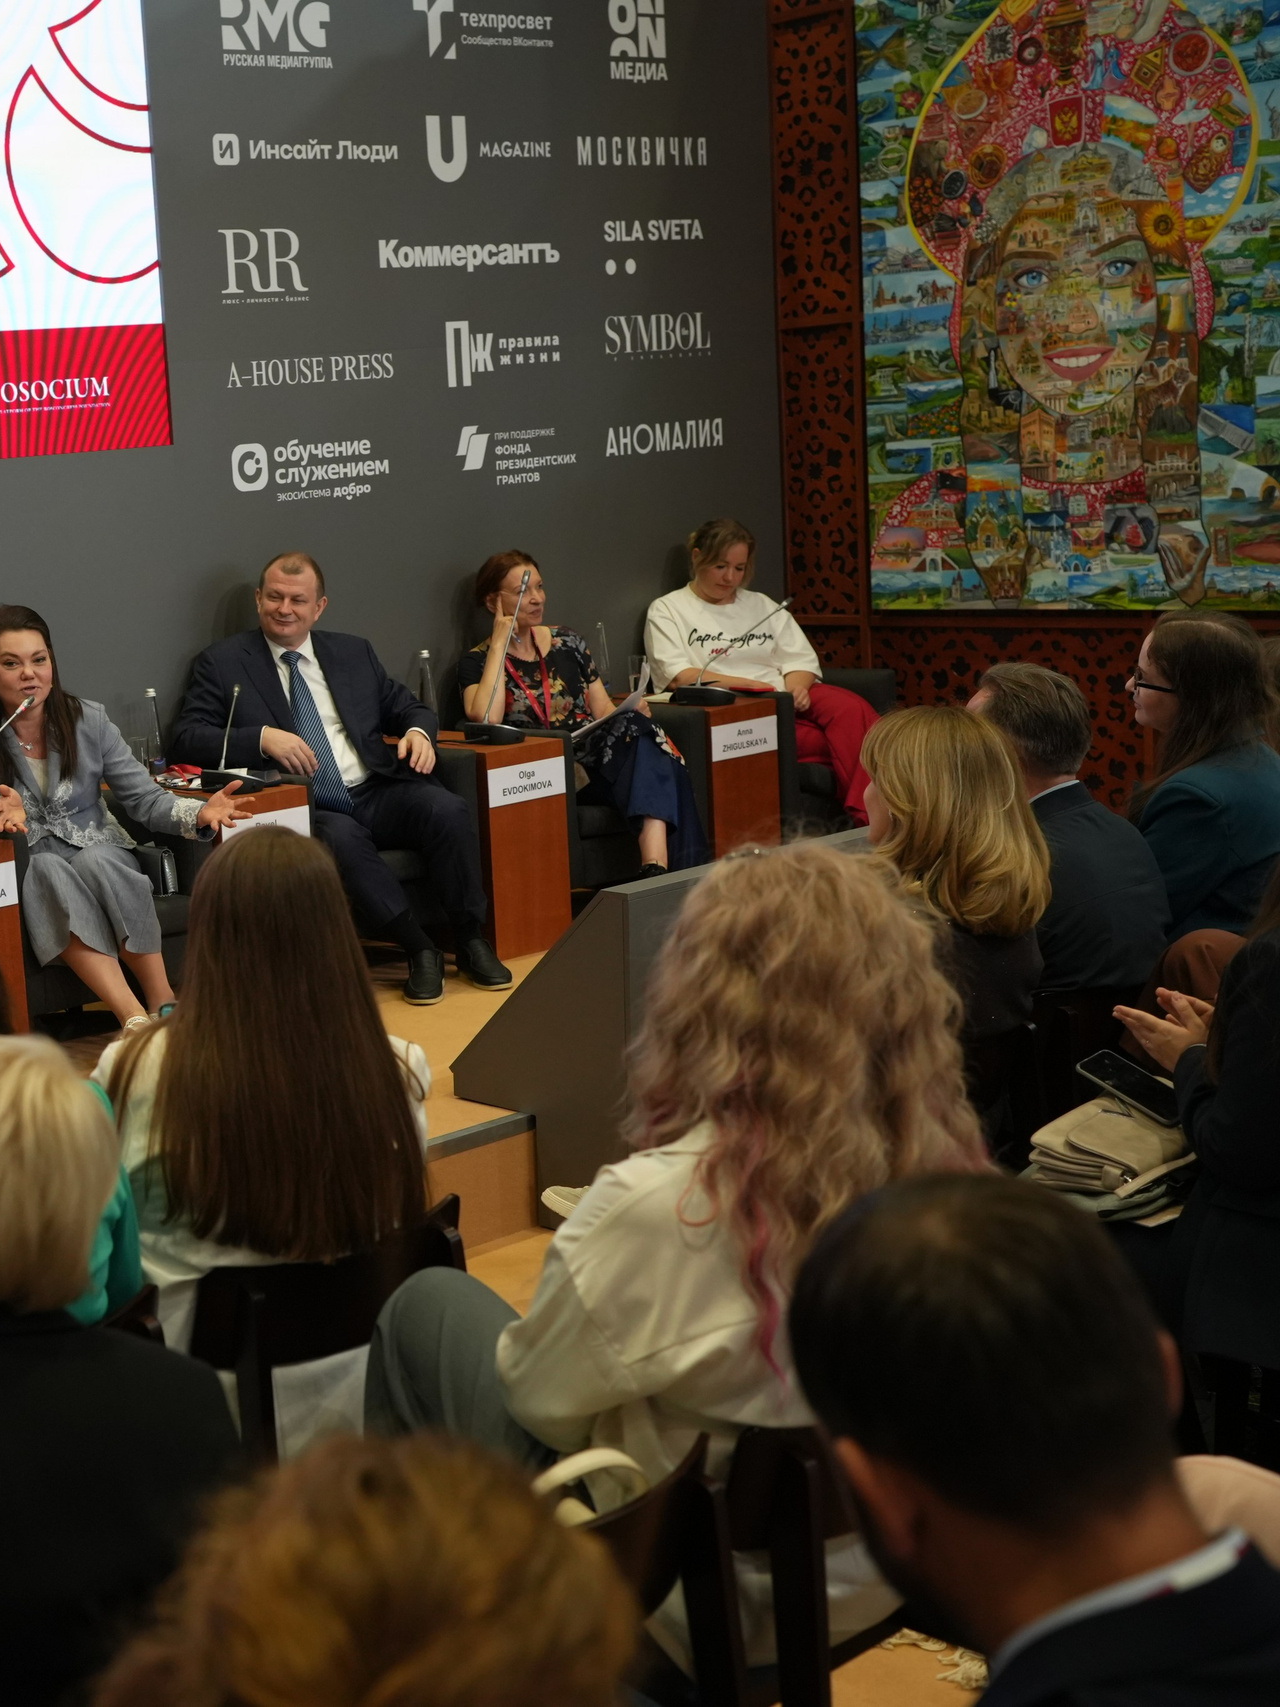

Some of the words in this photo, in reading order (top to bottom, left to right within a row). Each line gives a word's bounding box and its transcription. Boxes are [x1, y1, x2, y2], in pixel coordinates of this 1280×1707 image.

[460, 12, 553, 32] техпросвет
[461, 34, 512, 46] Сообщество
[513, 36, 554, 47] ВКонтакте
[223, 54, 265, 67] РУССКАЯ
[267, 55, 333, 69] МЕДИАГРУППА
[610, 61, 668, 83] МЕДИА
[249, 138, 332, 160] Инсайт
[336, 140, 399, 163] Люди
[425, 115, 468, 183] U
[479, 141, 552, 158] MAGAZINE
[576, 136, 708, 166] МОСКВИЧКА
[603, 220, 644, 242] SILA
[647, 219, 704, 241] SVETA
[218, 228, 309, 294] RR
[604, 312, 711, 355] SYMBOL
[499, 335, 560, 352] правила
[445, 320, 494, 388] ПЖ
[500, 351, 560, 365] жизни
[226, 356, 326, 388] A-HOUSE
[330, 352, 395, 383] PRESS
[494, 432, 509, 440] ПРИ
[510, 428, 555, 439] ПОДДЕРЖКЕ
[606, 418, 724, 457] АНОМАЛИЯ
[273, 439, 371, 465] обучение
[495, 443, 531, 455] ФОНДА
[496, 454, 576, 470] ПРЕЗИДЕНТСКИХ
[274, 459, 390, 487] служением
[496, 472, 540, 485] ГРАНТОВ
[276, 487, 331, 502] экосистема
[333, 483, 371, 499] добро
[736, 727, 753, 737] Anna
[722, 737, 768, 753] ZHIGULSKAYA
[518, 770, 535, 780] Olga
[502, 780, 552, 797] EVDOKIMOVA
